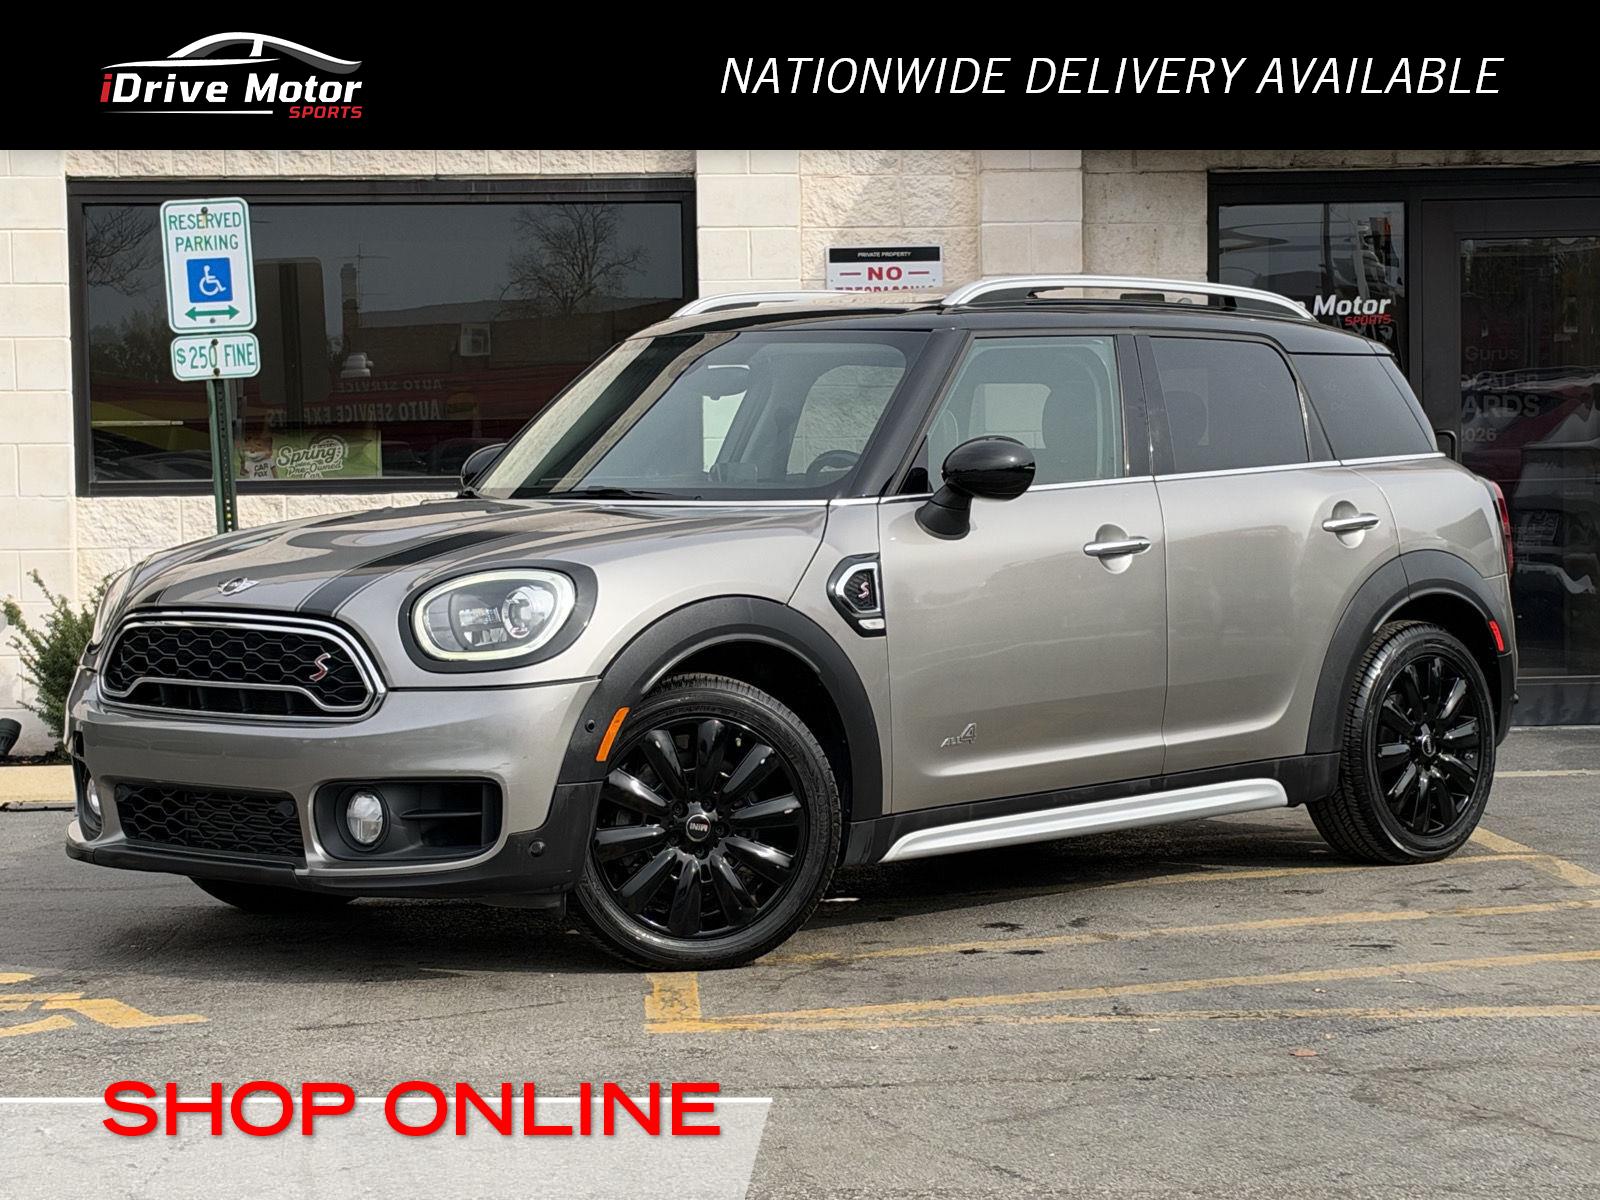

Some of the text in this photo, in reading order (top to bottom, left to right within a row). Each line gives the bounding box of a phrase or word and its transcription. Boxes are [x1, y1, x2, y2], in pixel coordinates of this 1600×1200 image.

[168, 211, 241, 231] RESERVED
[175, 234, 239, 252] PARKING
[867, 266, 903, 281] NO
[1313, 294, 1392, 316] Motor
[1344, 314, 1393, 326] SPORTS
[176, 343, 256, 370] $250 FINE
[1461, 428, 1497, 442] 026
[277, 446, 337, 467] Spring
[253, 470, 268, 478] FOX
[254, 463, 269, 471] CAR
[858, 581, 870, 599] S
[309, 652, 331, 683] S
[689, 822, 709, 832] MINI
